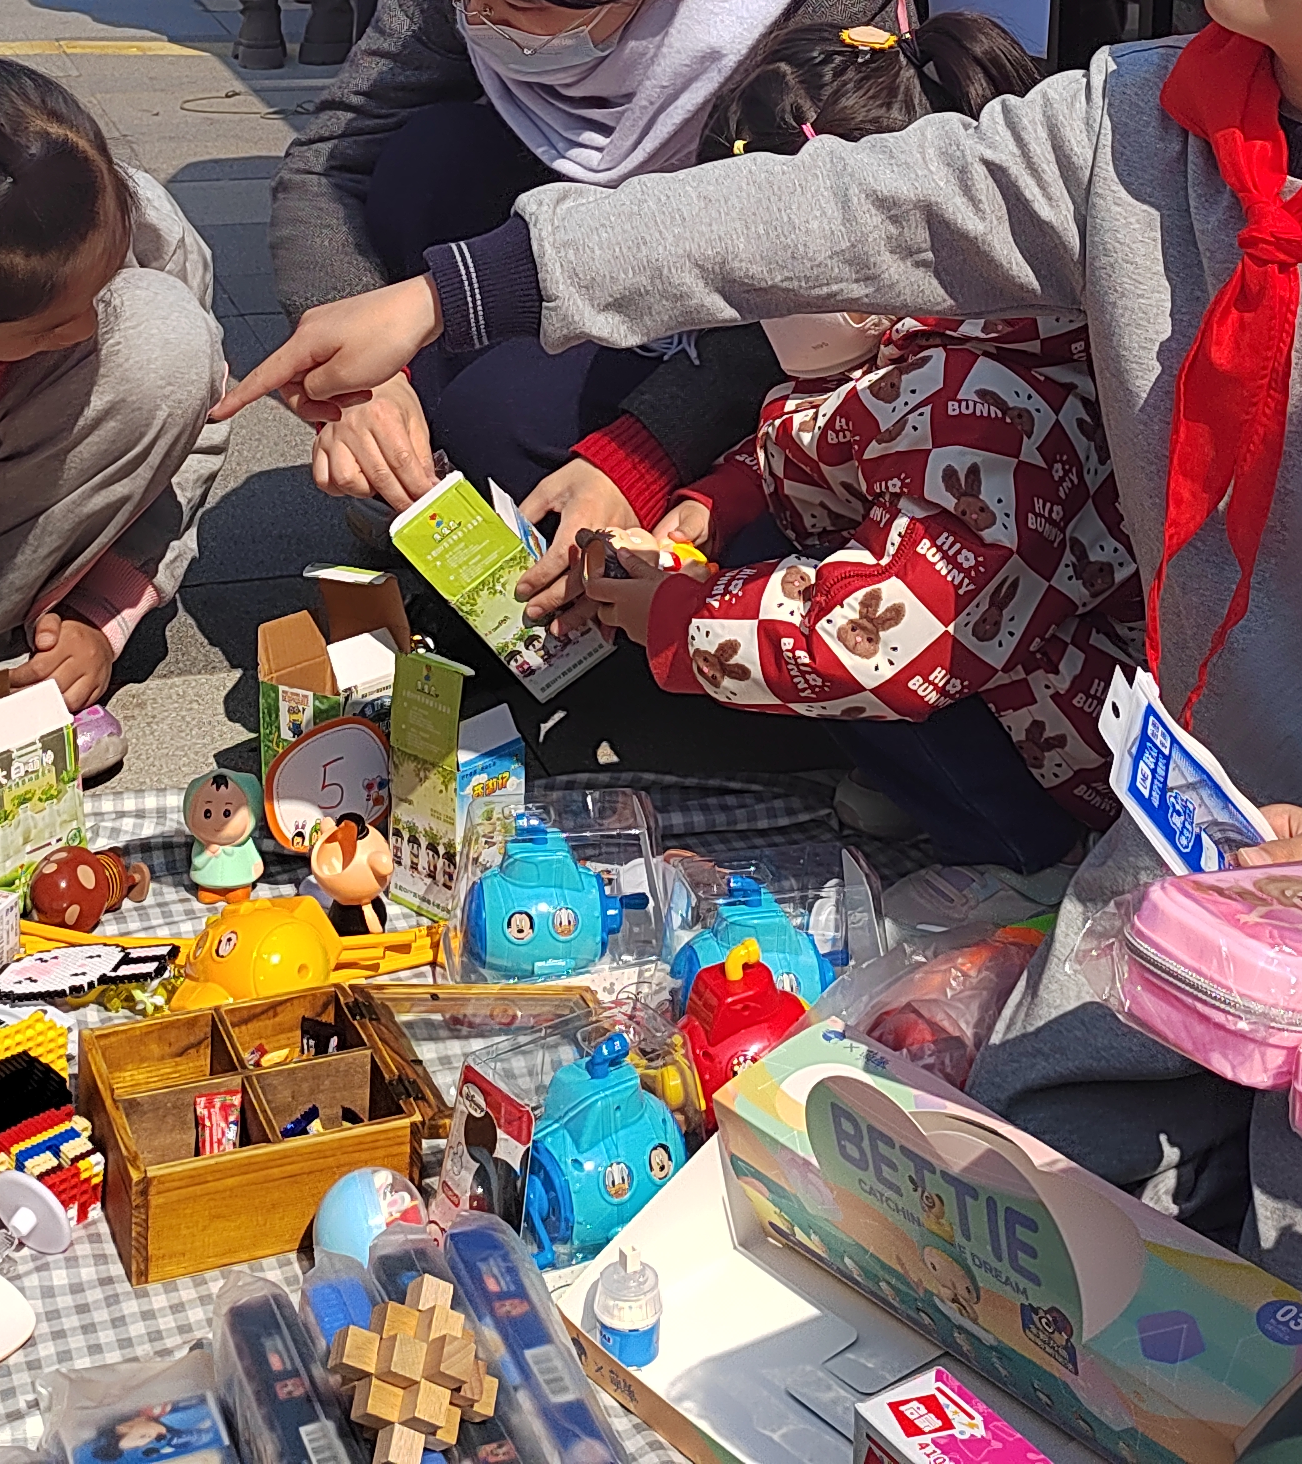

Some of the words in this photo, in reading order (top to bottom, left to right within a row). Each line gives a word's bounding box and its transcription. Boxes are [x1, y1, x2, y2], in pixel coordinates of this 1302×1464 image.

[915, 538, 977, 596] BUNNY
[935, 531, 959, 556] HI
[929, 667, 948, 688] HI
[317, 755, 345, 811] 5
[830, 1101, 1042, 1288] BETTIE
[857, 1177, 928, 1230] CATCHIN
